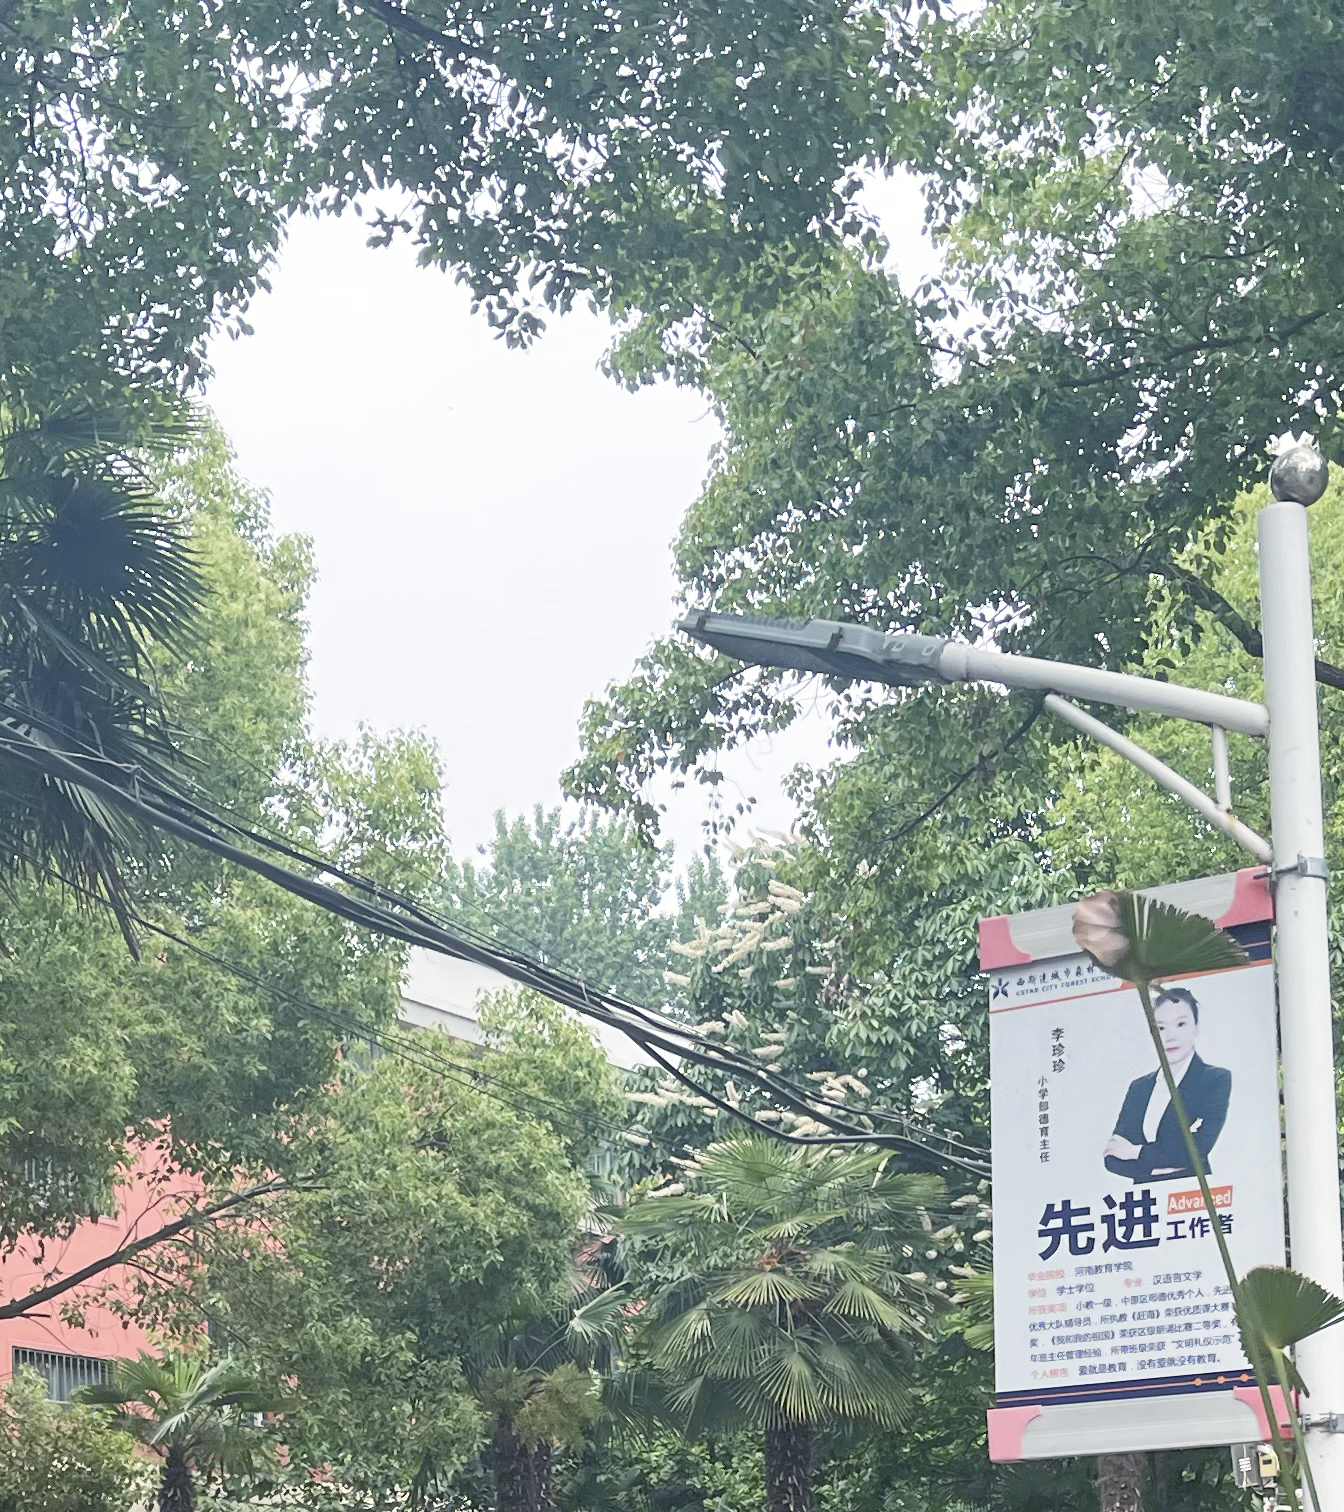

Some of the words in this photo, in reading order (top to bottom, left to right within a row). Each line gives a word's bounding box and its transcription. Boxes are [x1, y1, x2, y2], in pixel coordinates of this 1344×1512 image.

[1042, 983, 1059, 993] CITY
[1060, 978, 1088, 989] FOREST
[1051, 1027, 1066, 1073] 李珍珍
[1037, 1075, 1051, 1163] 小学部德育主任
[1038, 1189, 1161, 1261] 先进
[1166, 1213, 1234, 1240] 工作者
[1056, 1282, 1095, 1296] 学士学位
[1153, 1270, 1202, 1285] 汉语言文学
